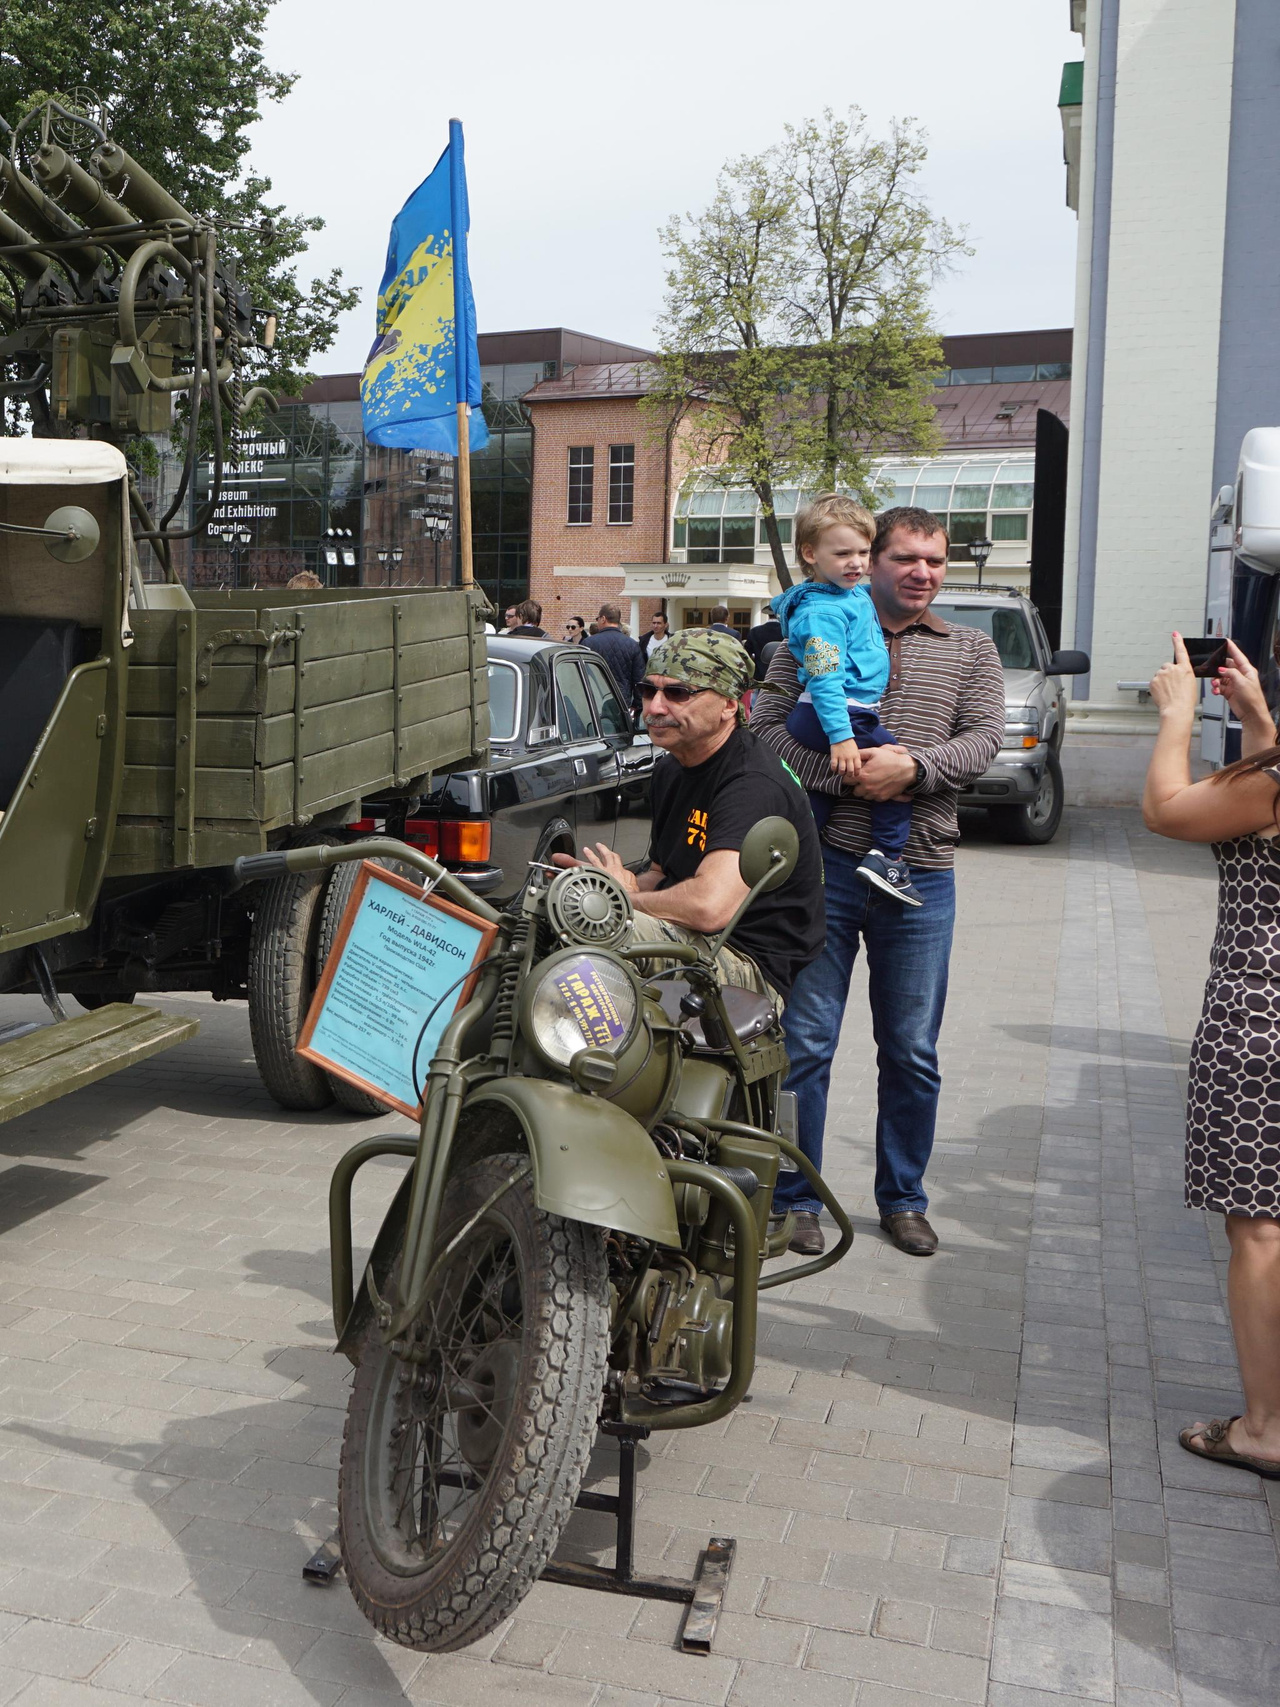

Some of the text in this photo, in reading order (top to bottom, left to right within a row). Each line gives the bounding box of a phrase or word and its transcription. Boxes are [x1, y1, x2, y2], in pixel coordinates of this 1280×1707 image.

[228, 505, 276, 517] Exhibition
[366, 898, 406, 926] ХАРЛЕЙ
[409, 923, 467, 961] ДАВИДСОН
[386, 924, 437, 957] Модель WLA-42
[348, 948, 371, 965] Двигатель
[350, 941, 379, 960] Техническая
[378, 931, 437, 968] Год выпуска 1942г.
[382, 944, 426, 971] Производство США
[343, 961, 362, 975] Рабочий
[381, 982, 389, 990] 739
[345, 955, 369, 972] Мощность
[337, 974, 354, 987] Расход
[353, 983, 372, 997] топлива
[340, 967, 360, 982] Коробка
[359, 978, 379, 993] передач
[335, 981, 369, 1003] Максимальная
[367, 999, 388, 1015] скорость
[396, 1016, 409, 1026] км/ч
[566, 973, 613, 1044] ГАРАЖ 777
[325, 1006, 334, 1014] Вес
[333, 1011, 358, 1029] мотоцикла
[357, 1025, 366, 1033] 257
[573, 1007, 583, 1019] 910
[579, 1019, 589, 1030] 595
[584, 1030, 593, 1038] 77
